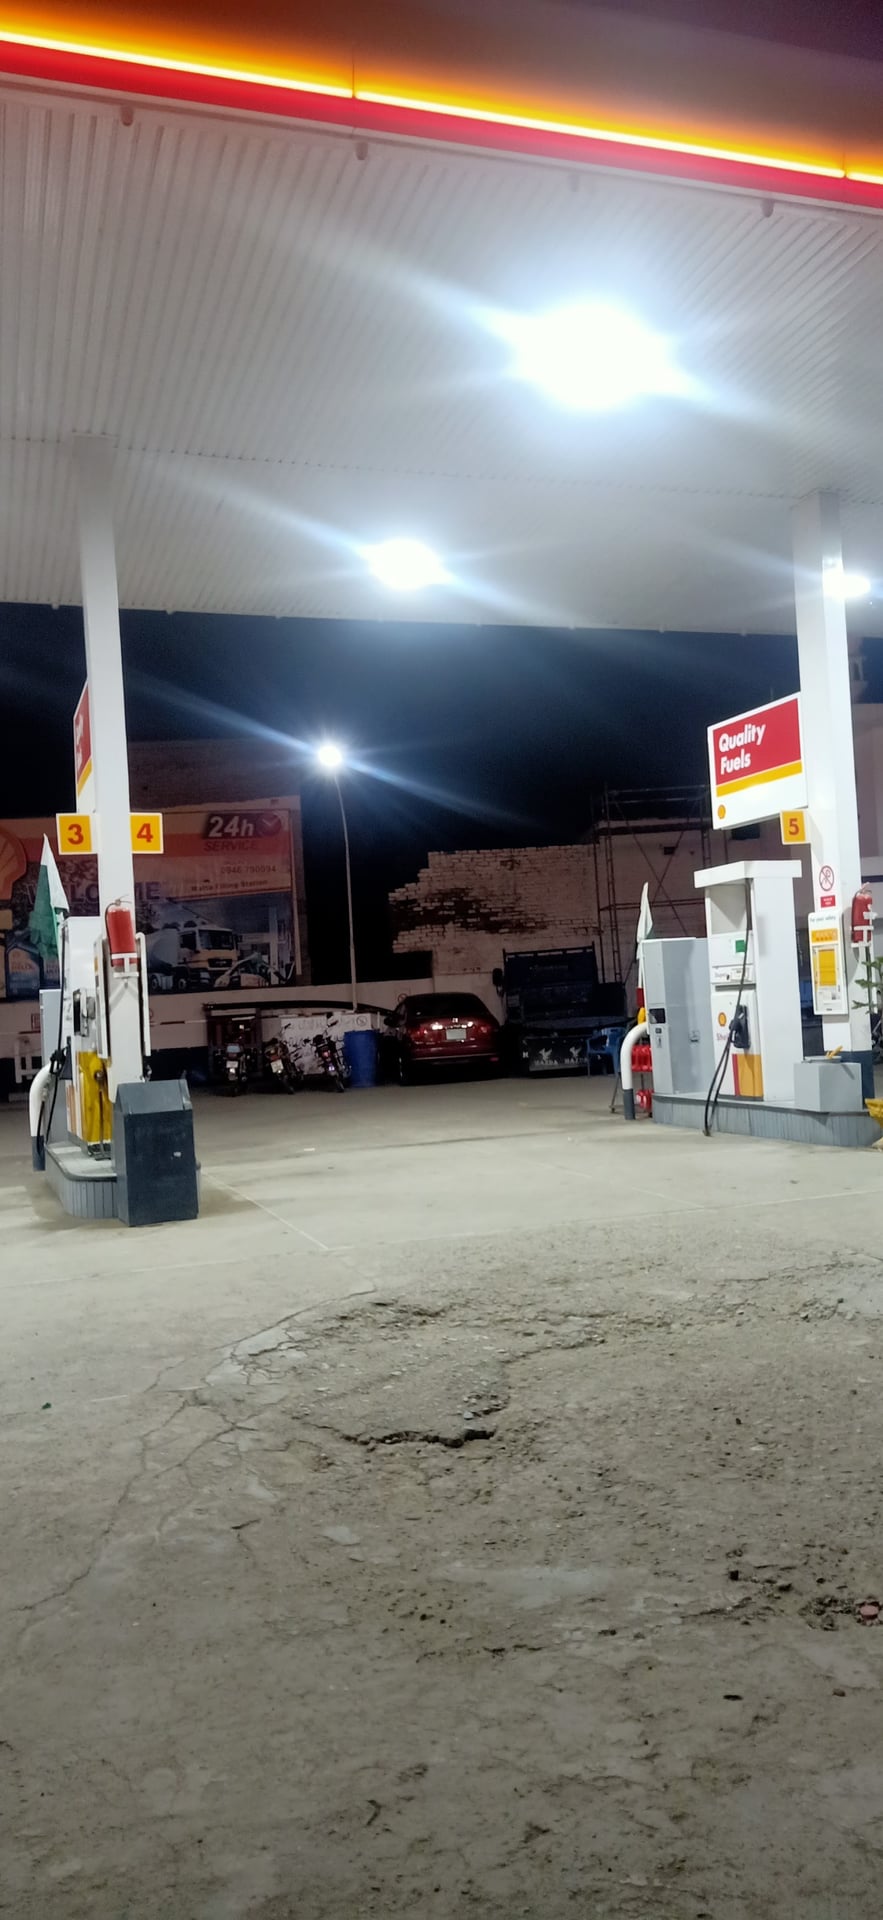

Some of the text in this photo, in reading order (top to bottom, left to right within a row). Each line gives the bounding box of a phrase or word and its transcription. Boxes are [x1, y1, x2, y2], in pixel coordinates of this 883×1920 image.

[719, 723, 766, 753] Quality
[720, 749, 751, 775] Fuels
[67, 823, 84, 845] 3
[136, 823, 154, 843] 4
[208, 815, 254, 837] 24h
[788, 818, 800, 835] 5
[203, 840, 257, 852] SERVICE
